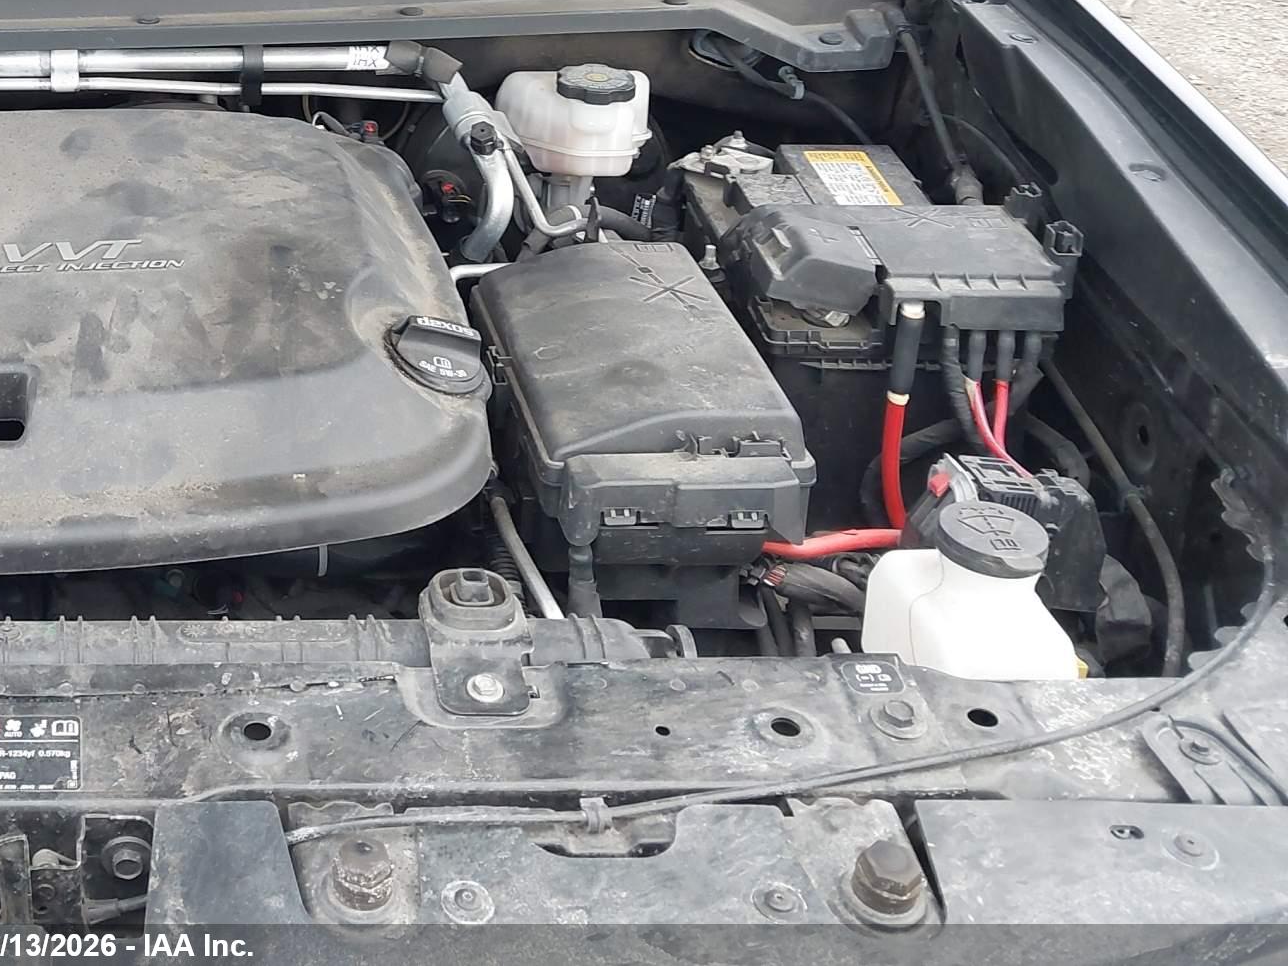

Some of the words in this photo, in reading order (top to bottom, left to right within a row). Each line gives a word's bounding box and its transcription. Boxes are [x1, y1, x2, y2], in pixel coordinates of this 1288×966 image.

[0, 238, 143, 264] VVT
[55, 258, 186, 273] INJECTION
[416, 316, 475, 337] dexos
